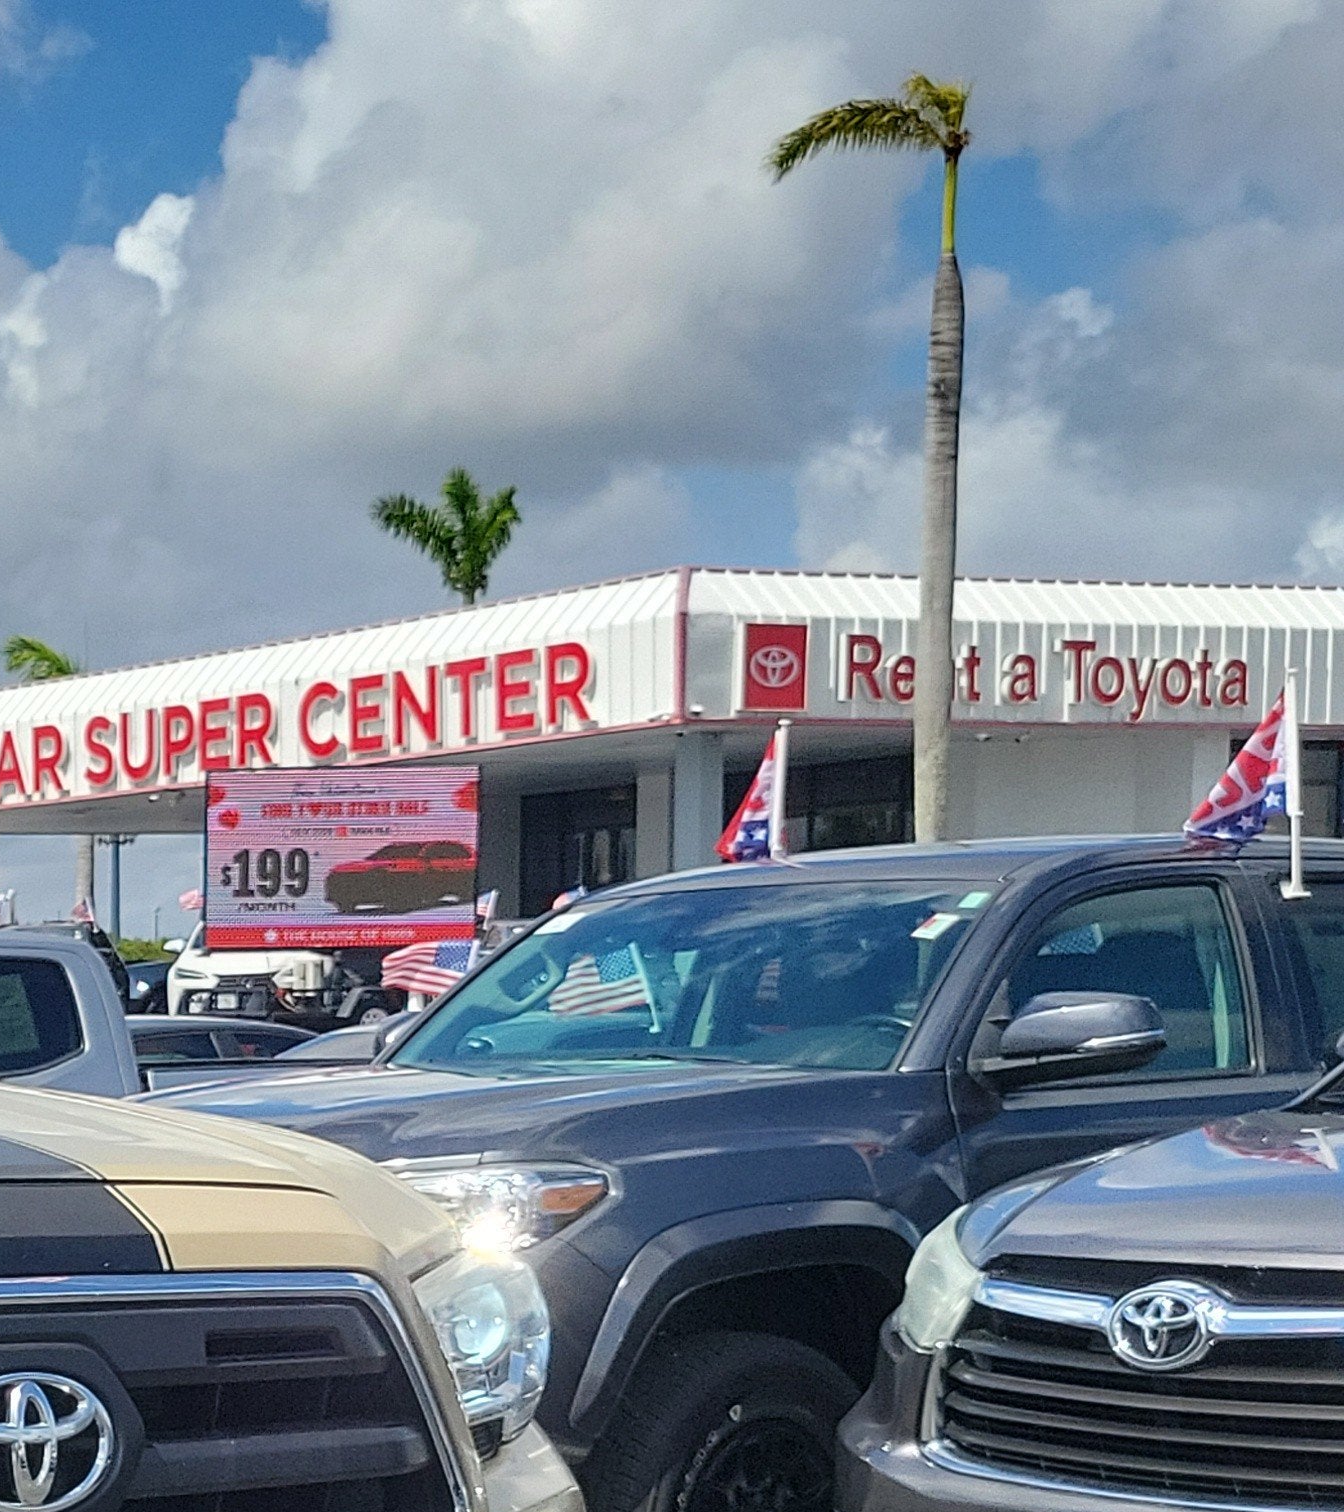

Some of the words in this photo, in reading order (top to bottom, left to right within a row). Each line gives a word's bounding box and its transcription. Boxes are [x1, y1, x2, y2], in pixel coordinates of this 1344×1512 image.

[83, 692, 273, 786] SUPER
[298, 641, 591, 758] CENTER
[848, 634, 981, 703] Ret
[1009, 654, 1038, 703] a
[1062, 640, 1249, 721] Toyota
